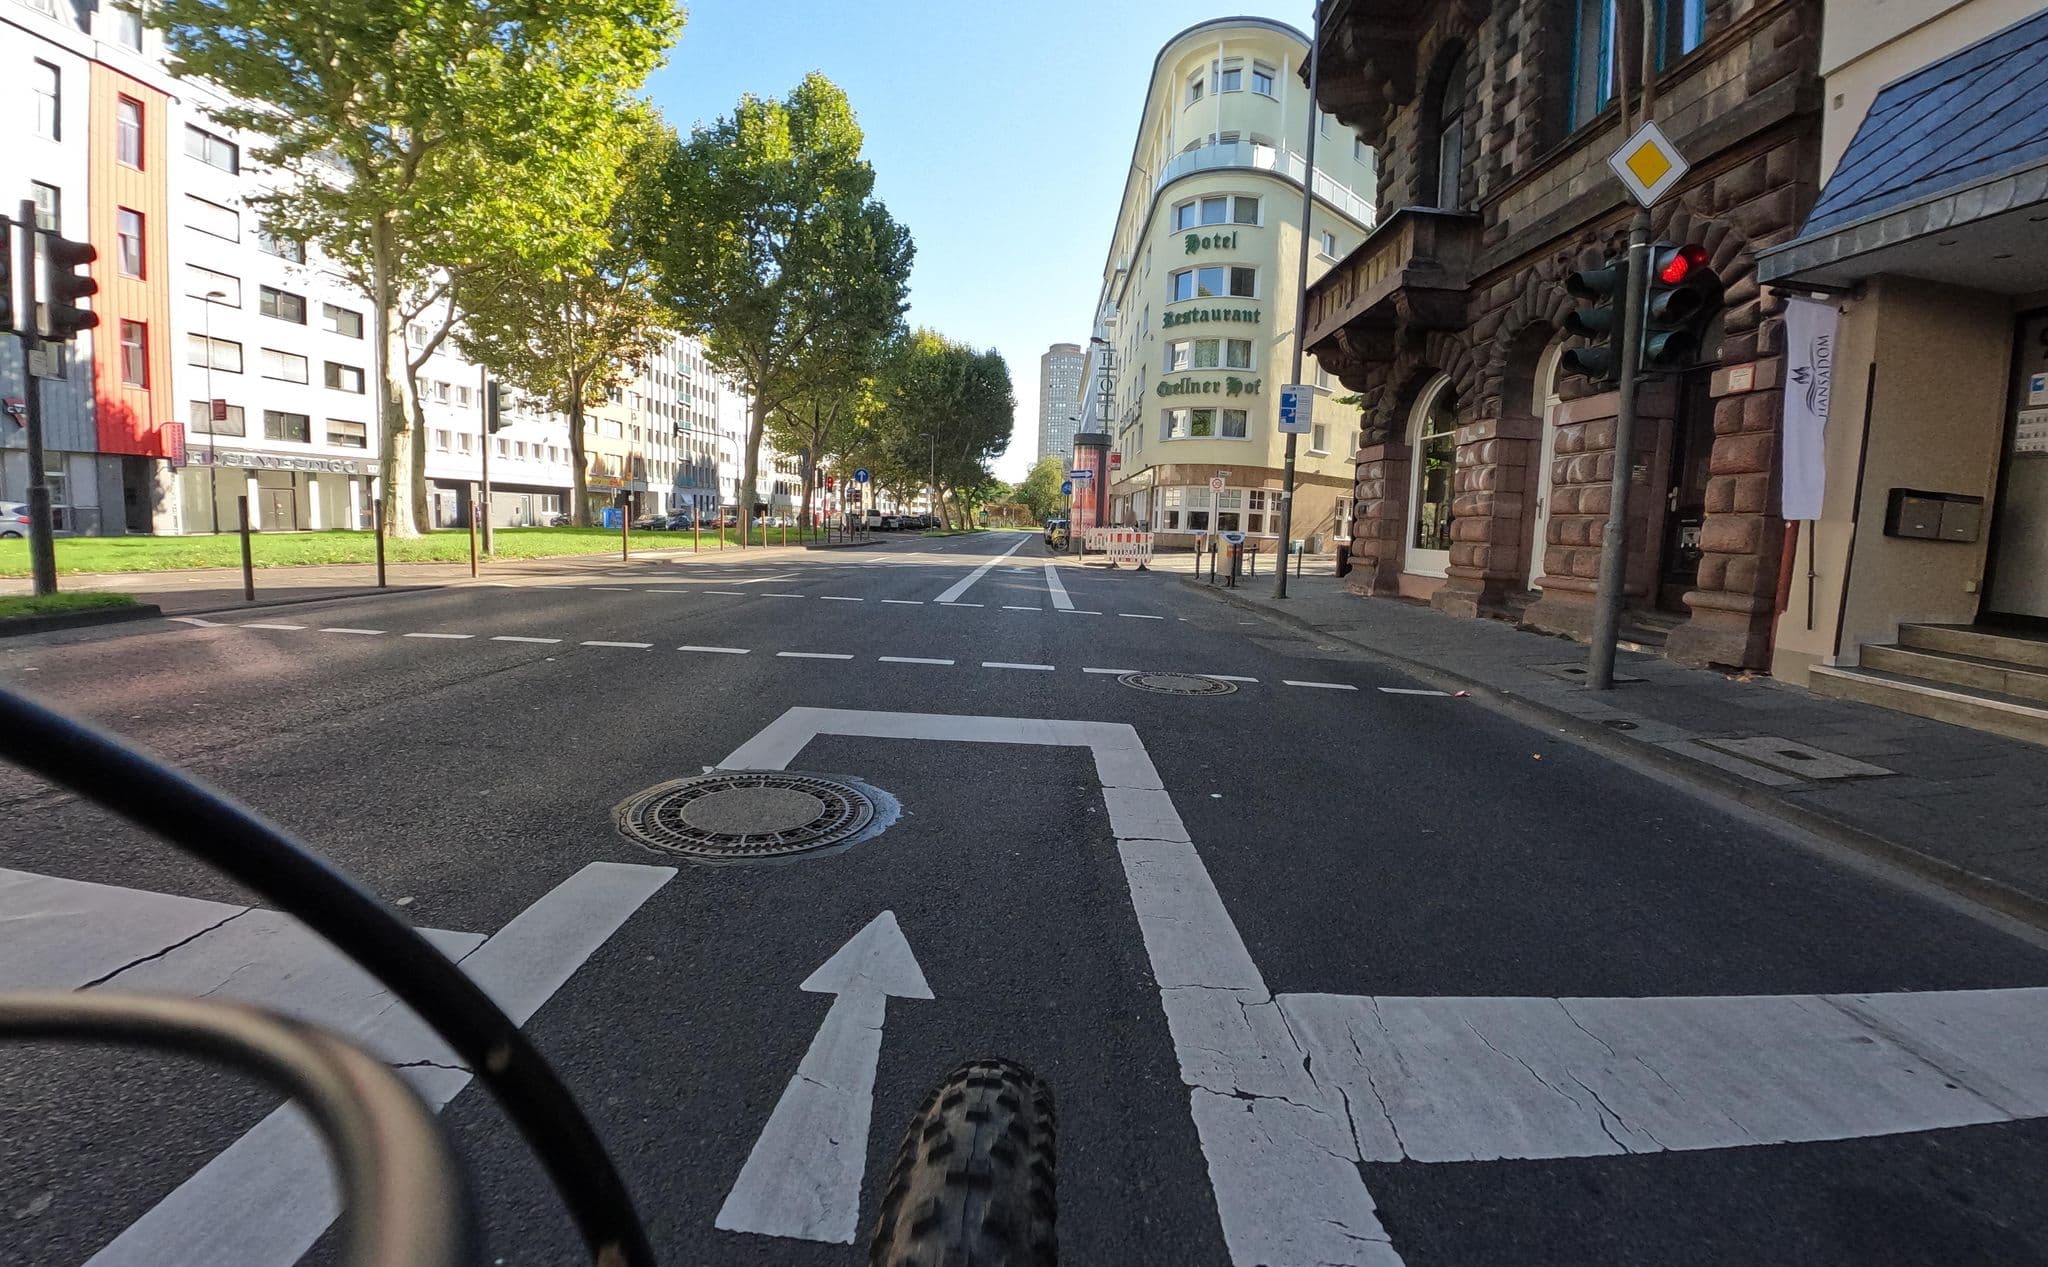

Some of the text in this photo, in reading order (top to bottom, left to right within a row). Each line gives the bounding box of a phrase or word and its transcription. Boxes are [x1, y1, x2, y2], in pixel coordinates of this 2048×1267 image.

[1184, 231, 1238, 255] Hotel
[1162, 307, 1262, 329] Restaurant
[1225, 376, 1262, 398] Hof
